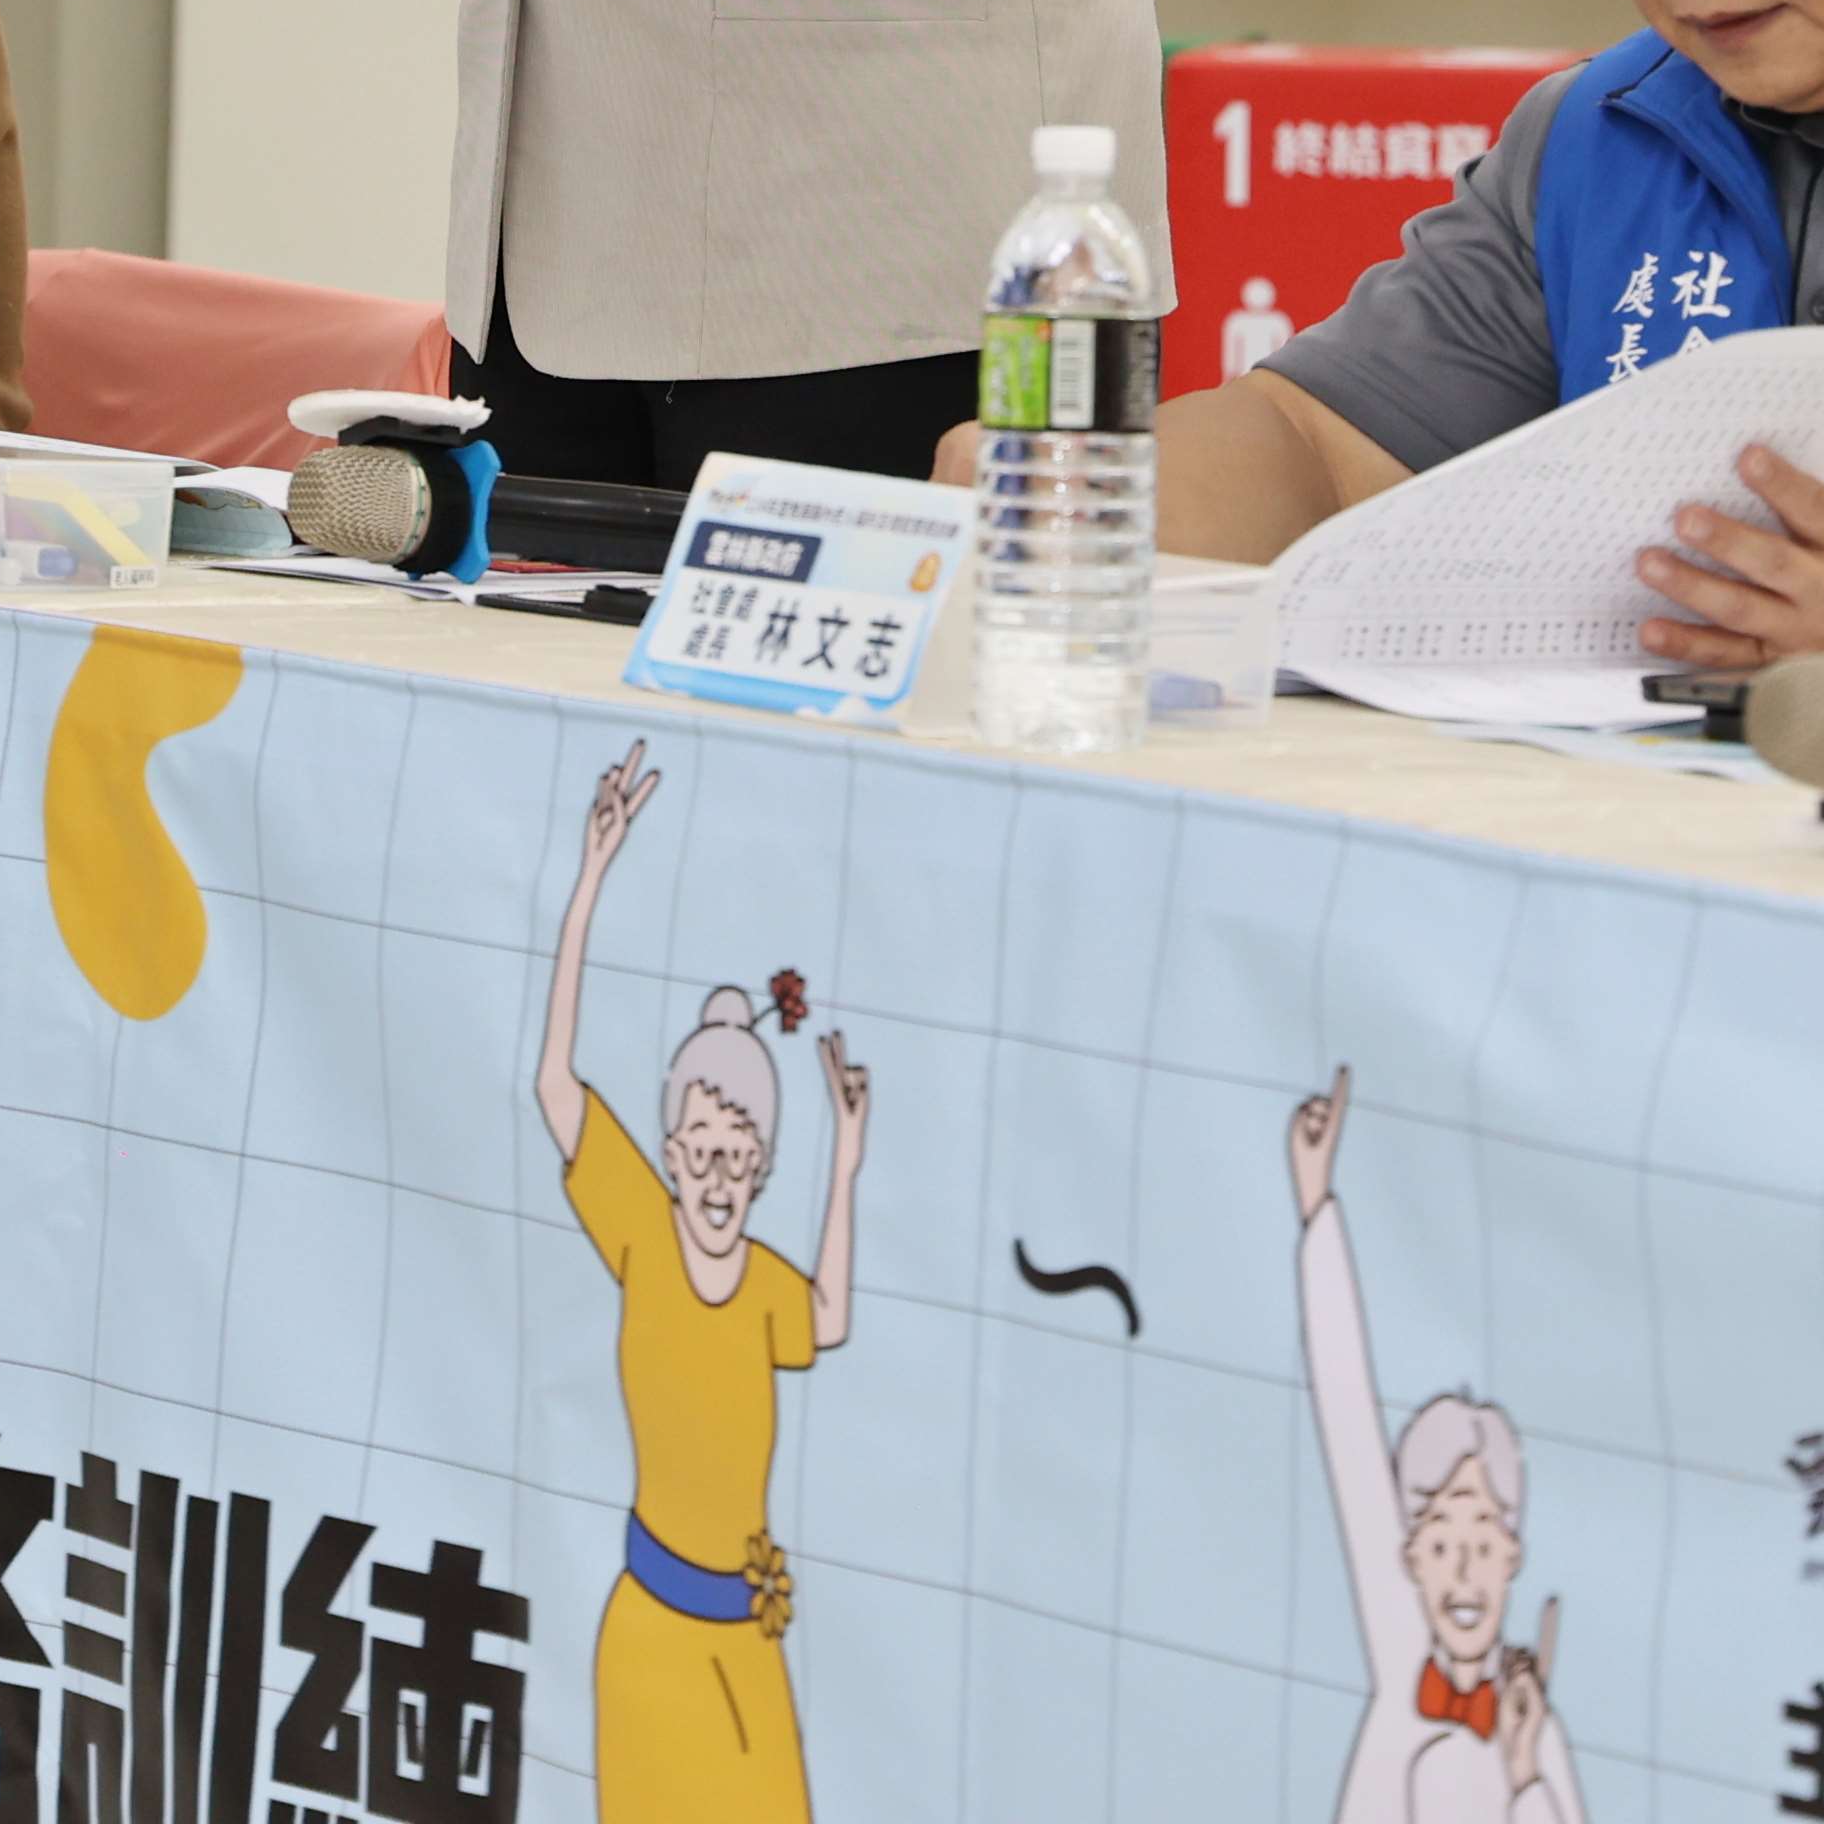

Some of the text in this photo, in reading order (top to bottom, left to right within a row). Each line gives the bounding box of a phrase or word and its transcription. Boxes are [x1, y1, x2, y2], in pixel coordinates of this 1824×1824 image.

[1213, 100, 1252, 207] 1
[755, 595, 903, 680] 林文志
